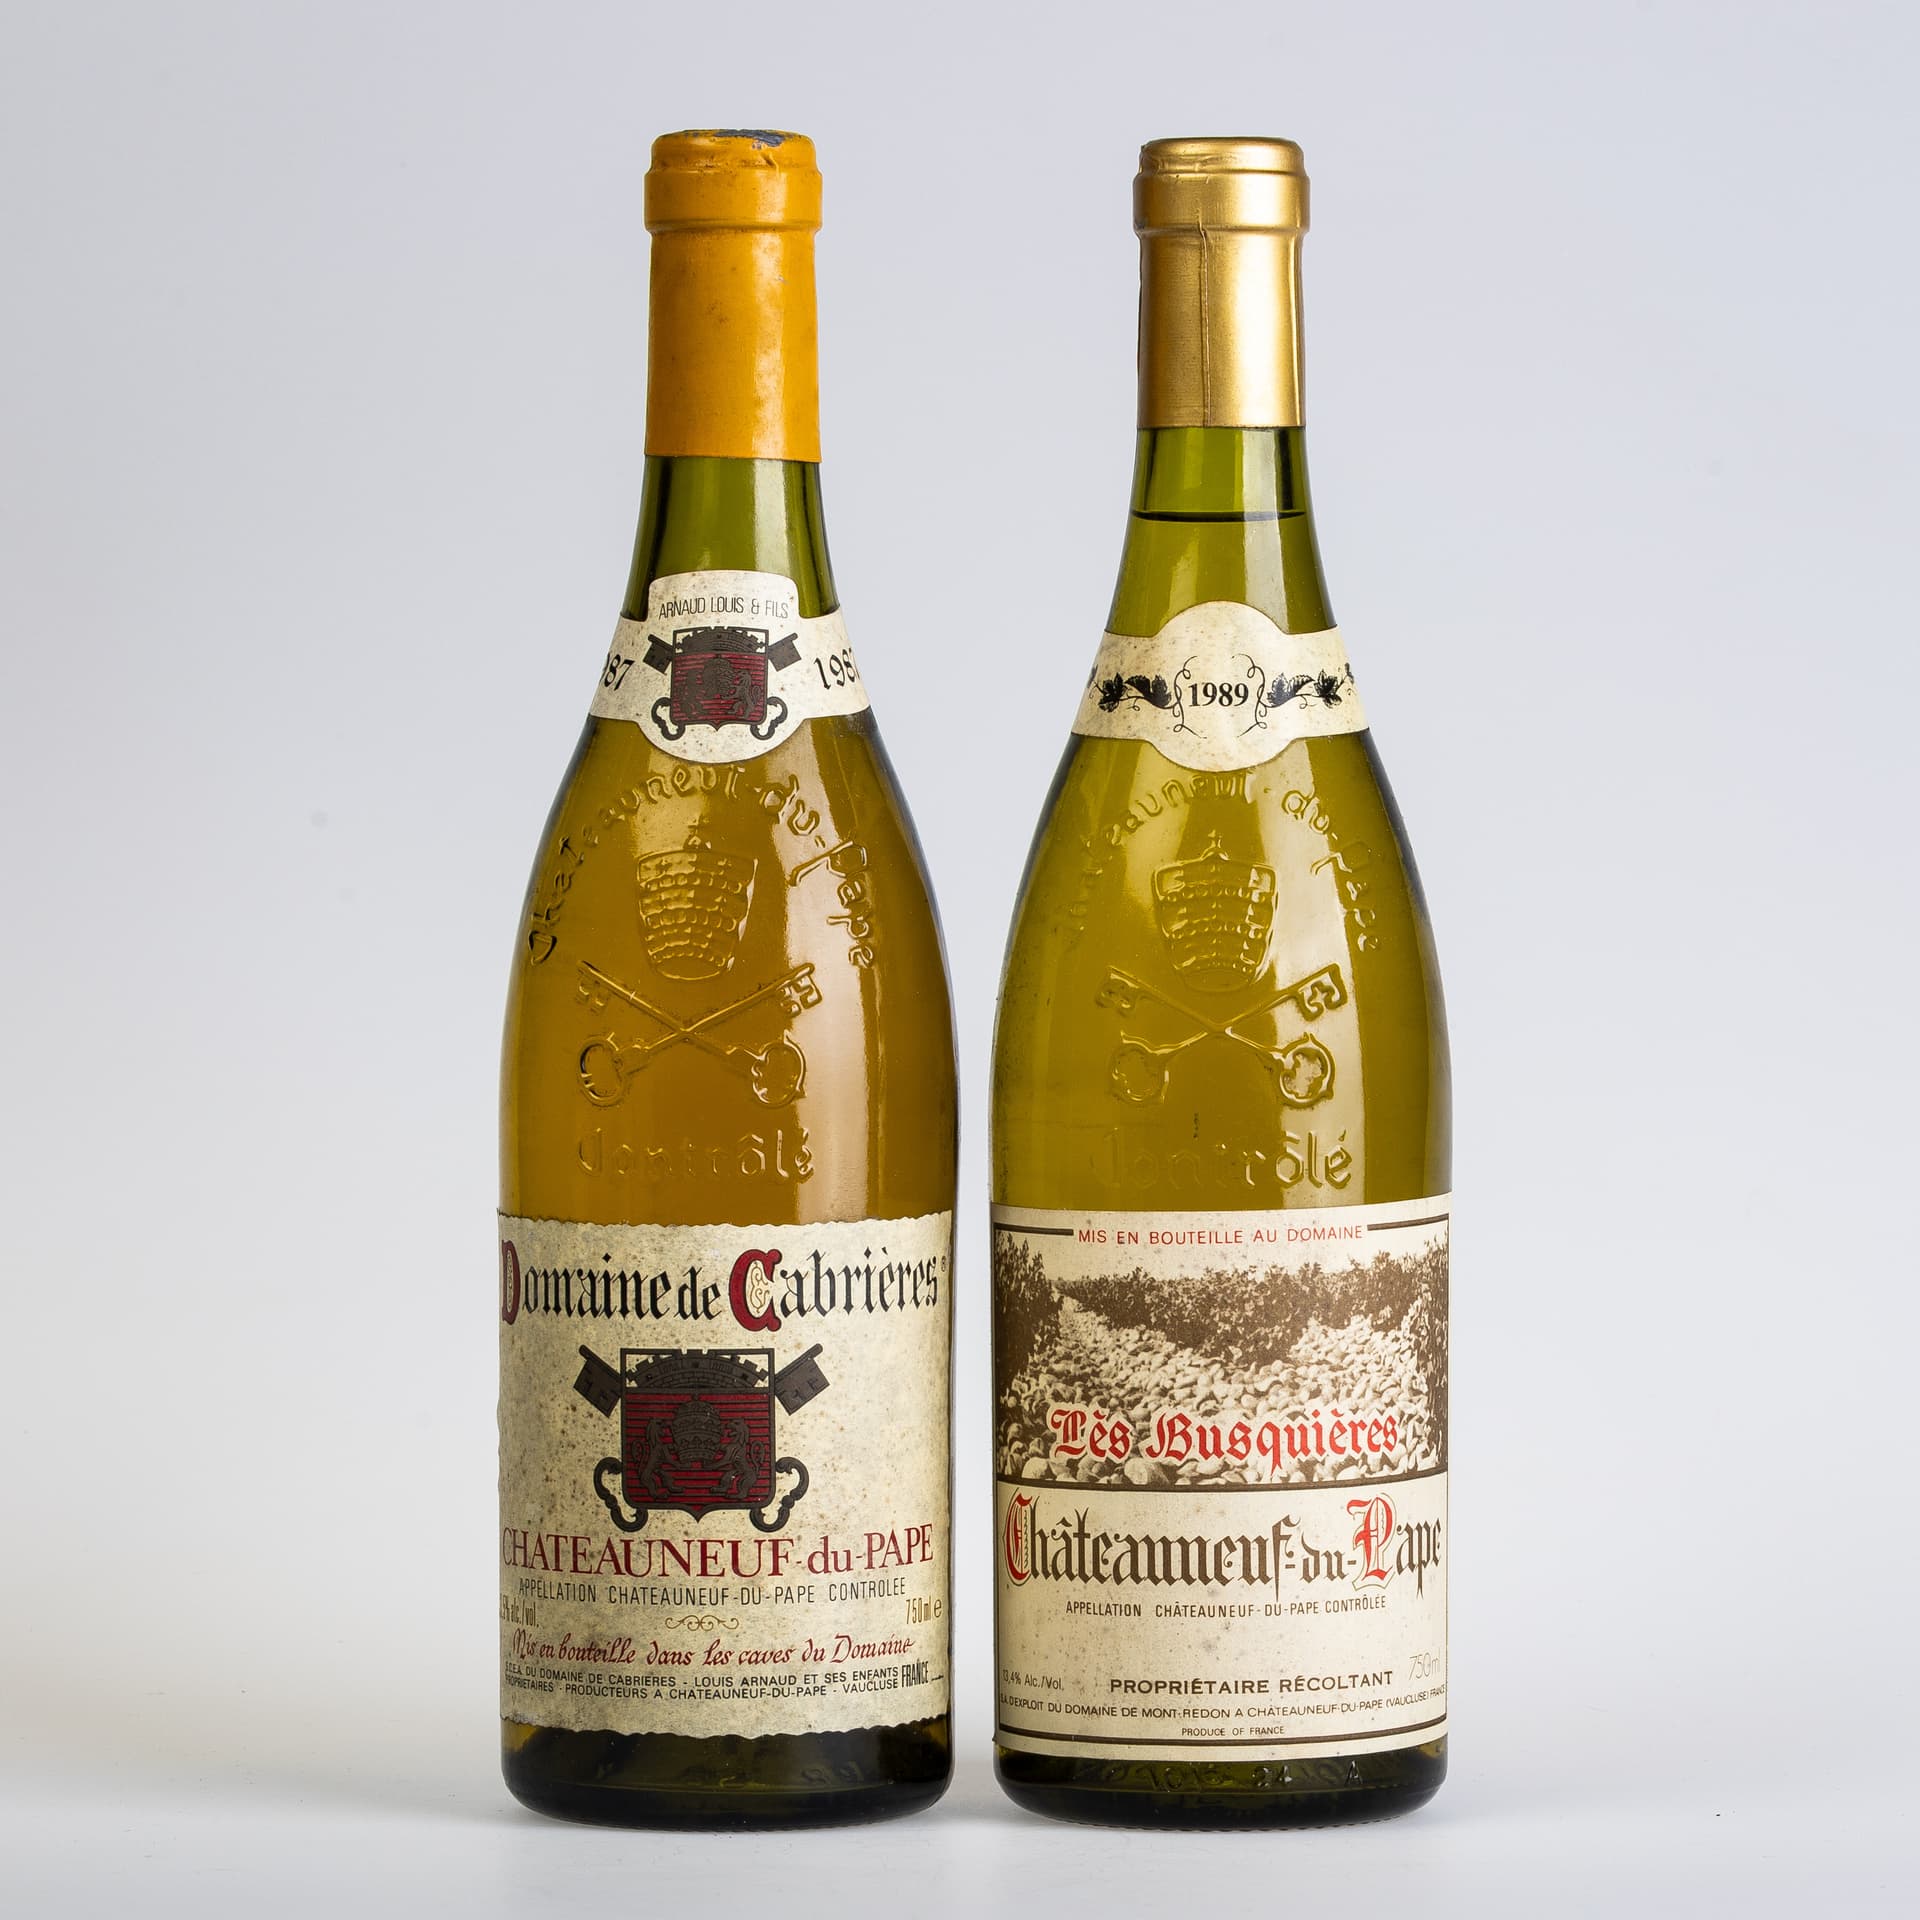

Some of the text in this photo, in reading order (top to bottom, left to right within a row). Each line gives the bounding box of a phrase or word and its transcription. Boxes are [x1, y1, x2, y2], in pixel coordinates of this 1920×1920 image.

[659, 596, 788, 620] ARNAUD LOUIS & FILS
[1188, 682, 1249, 708] 1989
[1078, 1225, 1363, 1245] MIS EN BOUTEILLE AU DOMAINE
[501, 1239, 672, 1326] Domaine
[674, 1265, 723, 1321] de
[728, 1246, 938, 1333] Cabrières
[1050, 1408, 1398, 1477] Lès Busquières
[518, 1577, 906, 1606] APPELLATION CHATEAUNEUF-DU-PAPE CONTROLEE
[1065, 1593, 1386, 1618] APPELLATION CHÂTEAUNEUF-DU-PAPE CONTRÔLÉE
[512, 1627, 916, 1666] Mis en bouteille dans les caves du Domaine
[525, 1666, 537, 1678] DU
[540, 1668, 584, 1683] DOMAINE
[588, 1673, 603, 1684] DE
[608, 1674, 677, 1687] CABRIERES
[694, 1676, 734, 1688] LOUIS
[740, 1674, 797, 1687] ARNAUD
[803, 1673, 819, 1685] ET
[824, 1671, 847, 1684] SES
[852, 1666, 899, 1682] ENFANTS
[901, 1660, 929, 1688] FRANCE
[1110, 1670, 1393, 1695] PROPRIÉTAIRE RÉCOLTANT
[565, 1683, 648, 1699] PRODUCTEURS
[654, 1688, 663, 1699] A
[669, 1685, 827, 1700] CHATEAUNEUF-DU-PAPE
[842, 1678, 899, 1694] VAUCLUSE
[1048, 1702, 1061, 1713] DU
[1065, 1704, 1117, 1717] DOMAINE
[1121, 1707, 1137, 1717] DE
[1181, 1726, 1285, 1737] PRODUCE OF FRANCE
